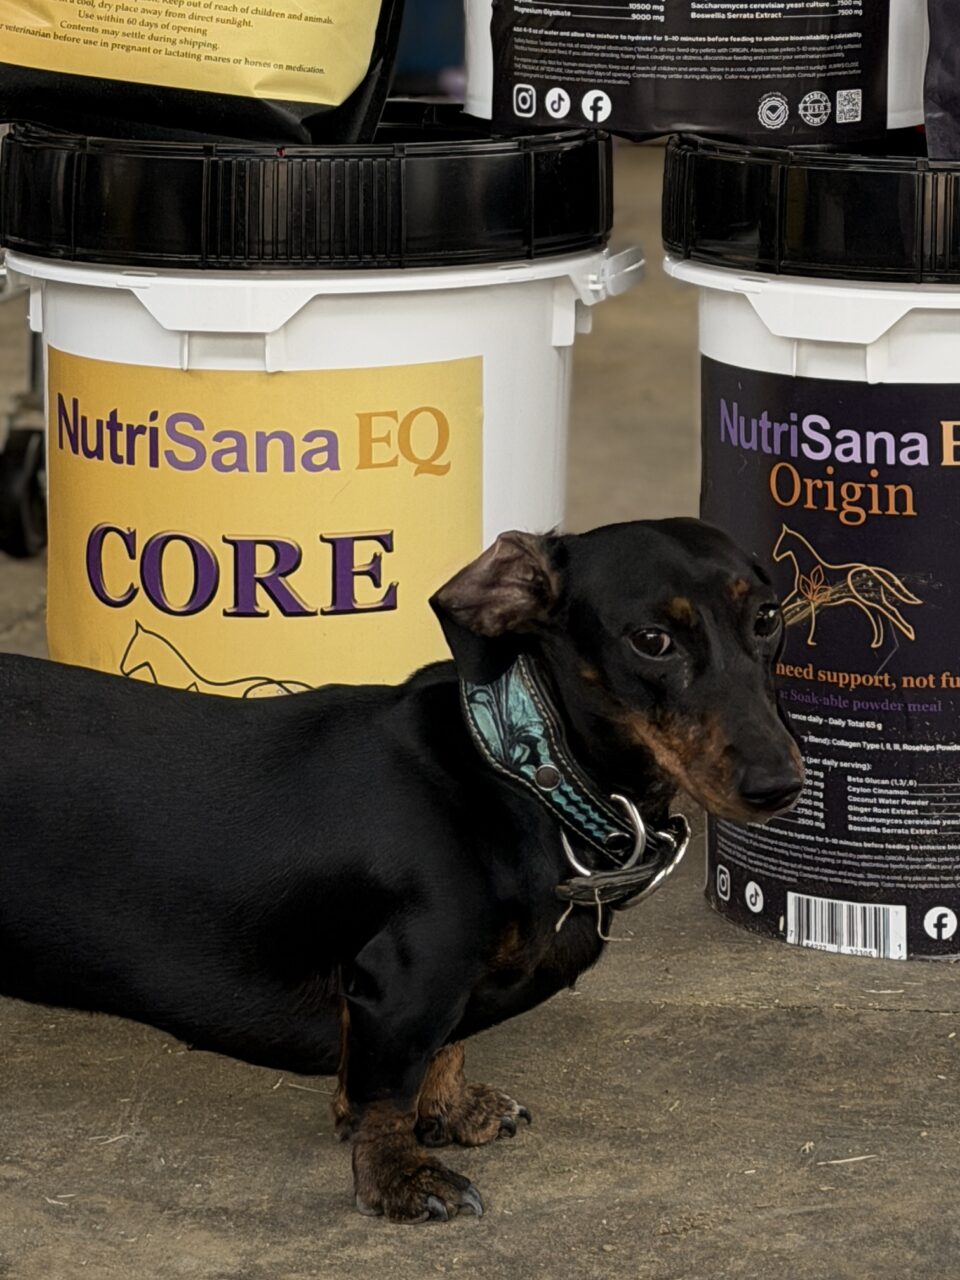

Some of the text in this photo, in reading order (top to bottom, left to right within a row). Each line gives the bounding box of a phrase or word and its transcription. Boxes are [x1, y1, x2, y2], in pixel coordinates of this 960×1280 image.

[78, 9, 207, 36] Use within 60 days of opening
[97, 0, 113, 11] dry
[114, 2, 138, 12] place
[140, 7, 163, 17] away
[164, 8, 186, 18] from
[187, 11, 213, 22] direct
[215, 17, 253, 28] sunlight.
[186, 0, 201, 8] out
[202, 0, 213, 9] of
[214, 3, 238, 12] reach
[239, 5, 250, 14] of
[250, 7, 285, 18] children
[286, 12, 303, 21] and
[303, 15, 334, 24] animals.
[5, 25, 51, 38] veterinarian
[52, 31, 81, 43] before
[82, 38, 98, 46] use
[99, 38, 109, 47] in
[110, 42, 151, 53] pregnant
[164, 47, 202, 61] lactating
[204, 54, 231, 63] mares
[244, 56, 271, 67] horses
[284, 64, 325, 74] medication.
[59, 20, 219, 51] Contents may settle during shipping.
[57, 391, 452, 477] NutriSana EQ
[719, 398, 929, 467] NutriSana
[769, 462, 918, 526] Origin
[84, 521, 400, 619] CORE
[776, 663, 813, 679] need
[817, 670, 896, 690] support,
[902, 674, 935, 688] not
[790, 690, 942, 712] Soak-able powder meal
[807, 715, 823, 725] daily
[829, 718, 846, 728] Daily
[847, 719, 865, 728] Total
